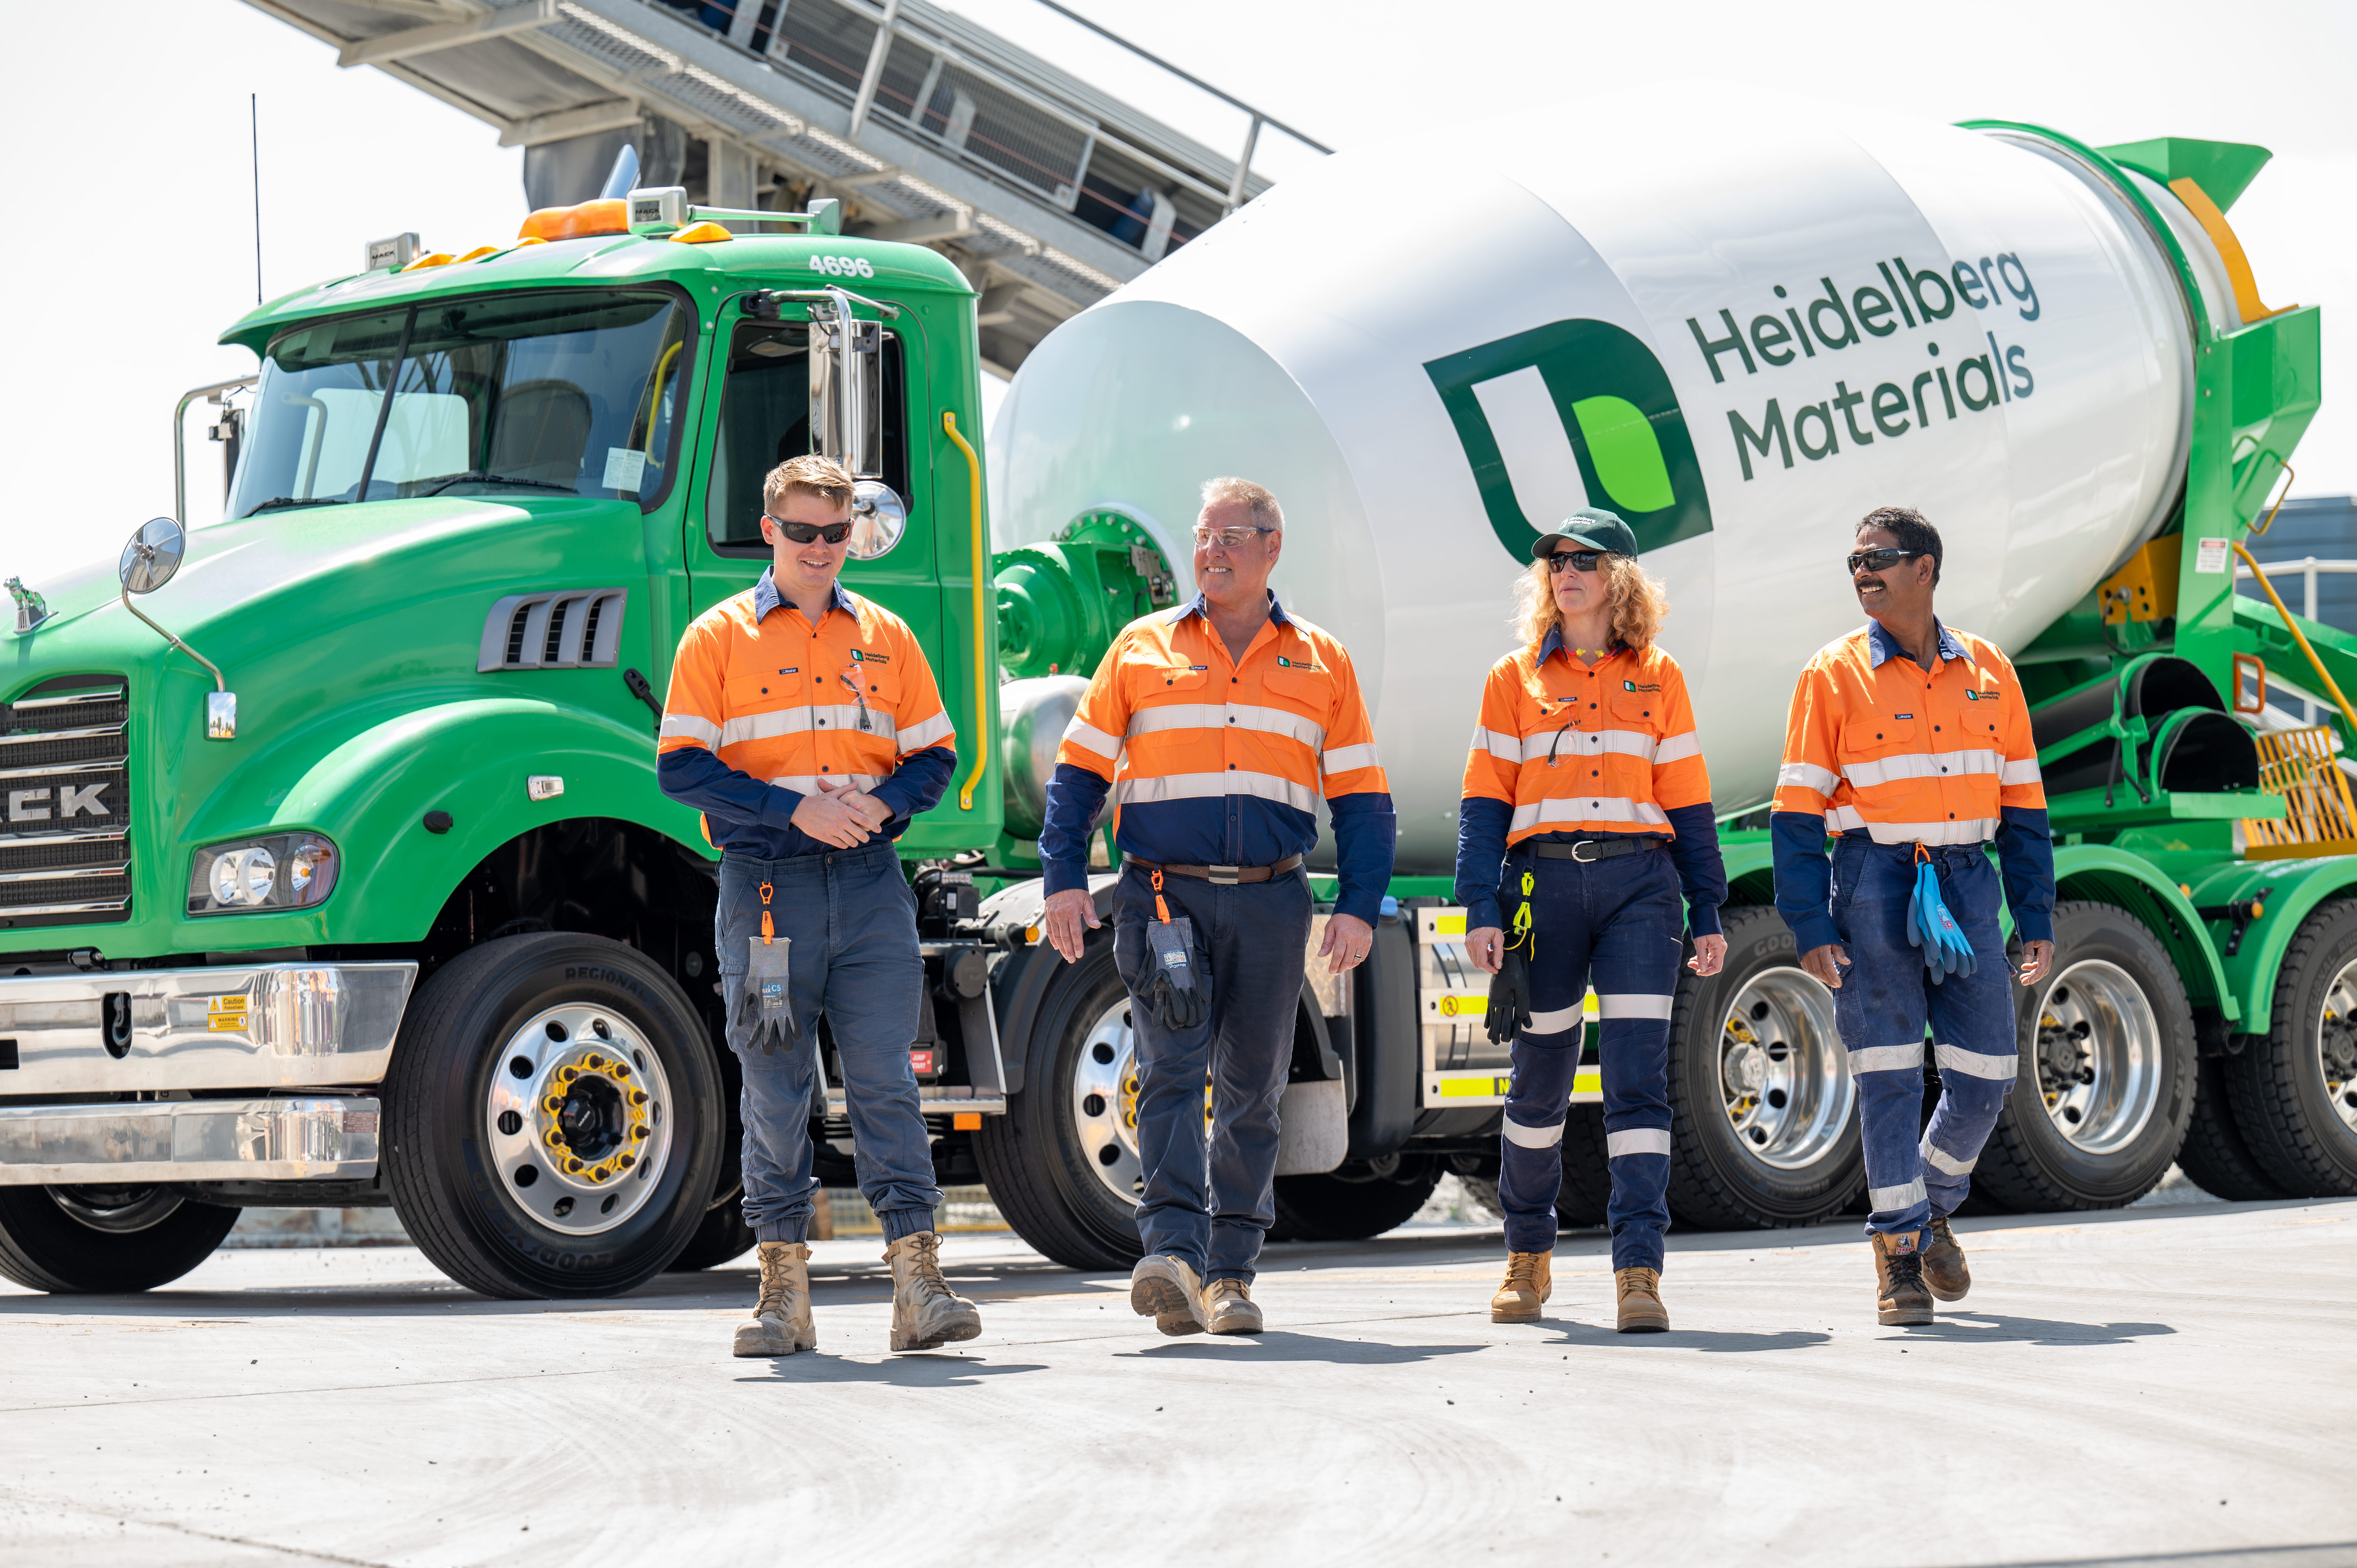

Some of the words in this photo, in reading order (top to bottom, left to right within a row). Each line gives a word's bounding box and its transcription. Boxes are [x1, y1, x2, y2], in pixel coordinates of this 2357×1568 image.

[372, 250, 394, 259] MACK
[809, 255, 874, 278] 4696
[1686, 252, 2040, 383] Heidelberg
[1726, 330, 2034, 482] Materials
[865, 652, 889, 660] Heidelberg
[1292, 661, 1320, 669] Heidelberg
[0, 783, 110, 822] CK
[1753, 934, 1793, 957] GOO
[565, 966, 647, 1000] REGIONAL
[1499, 1078, 1511, 1095] N
[473, 1171, 614, 1270] GOODYEAR
